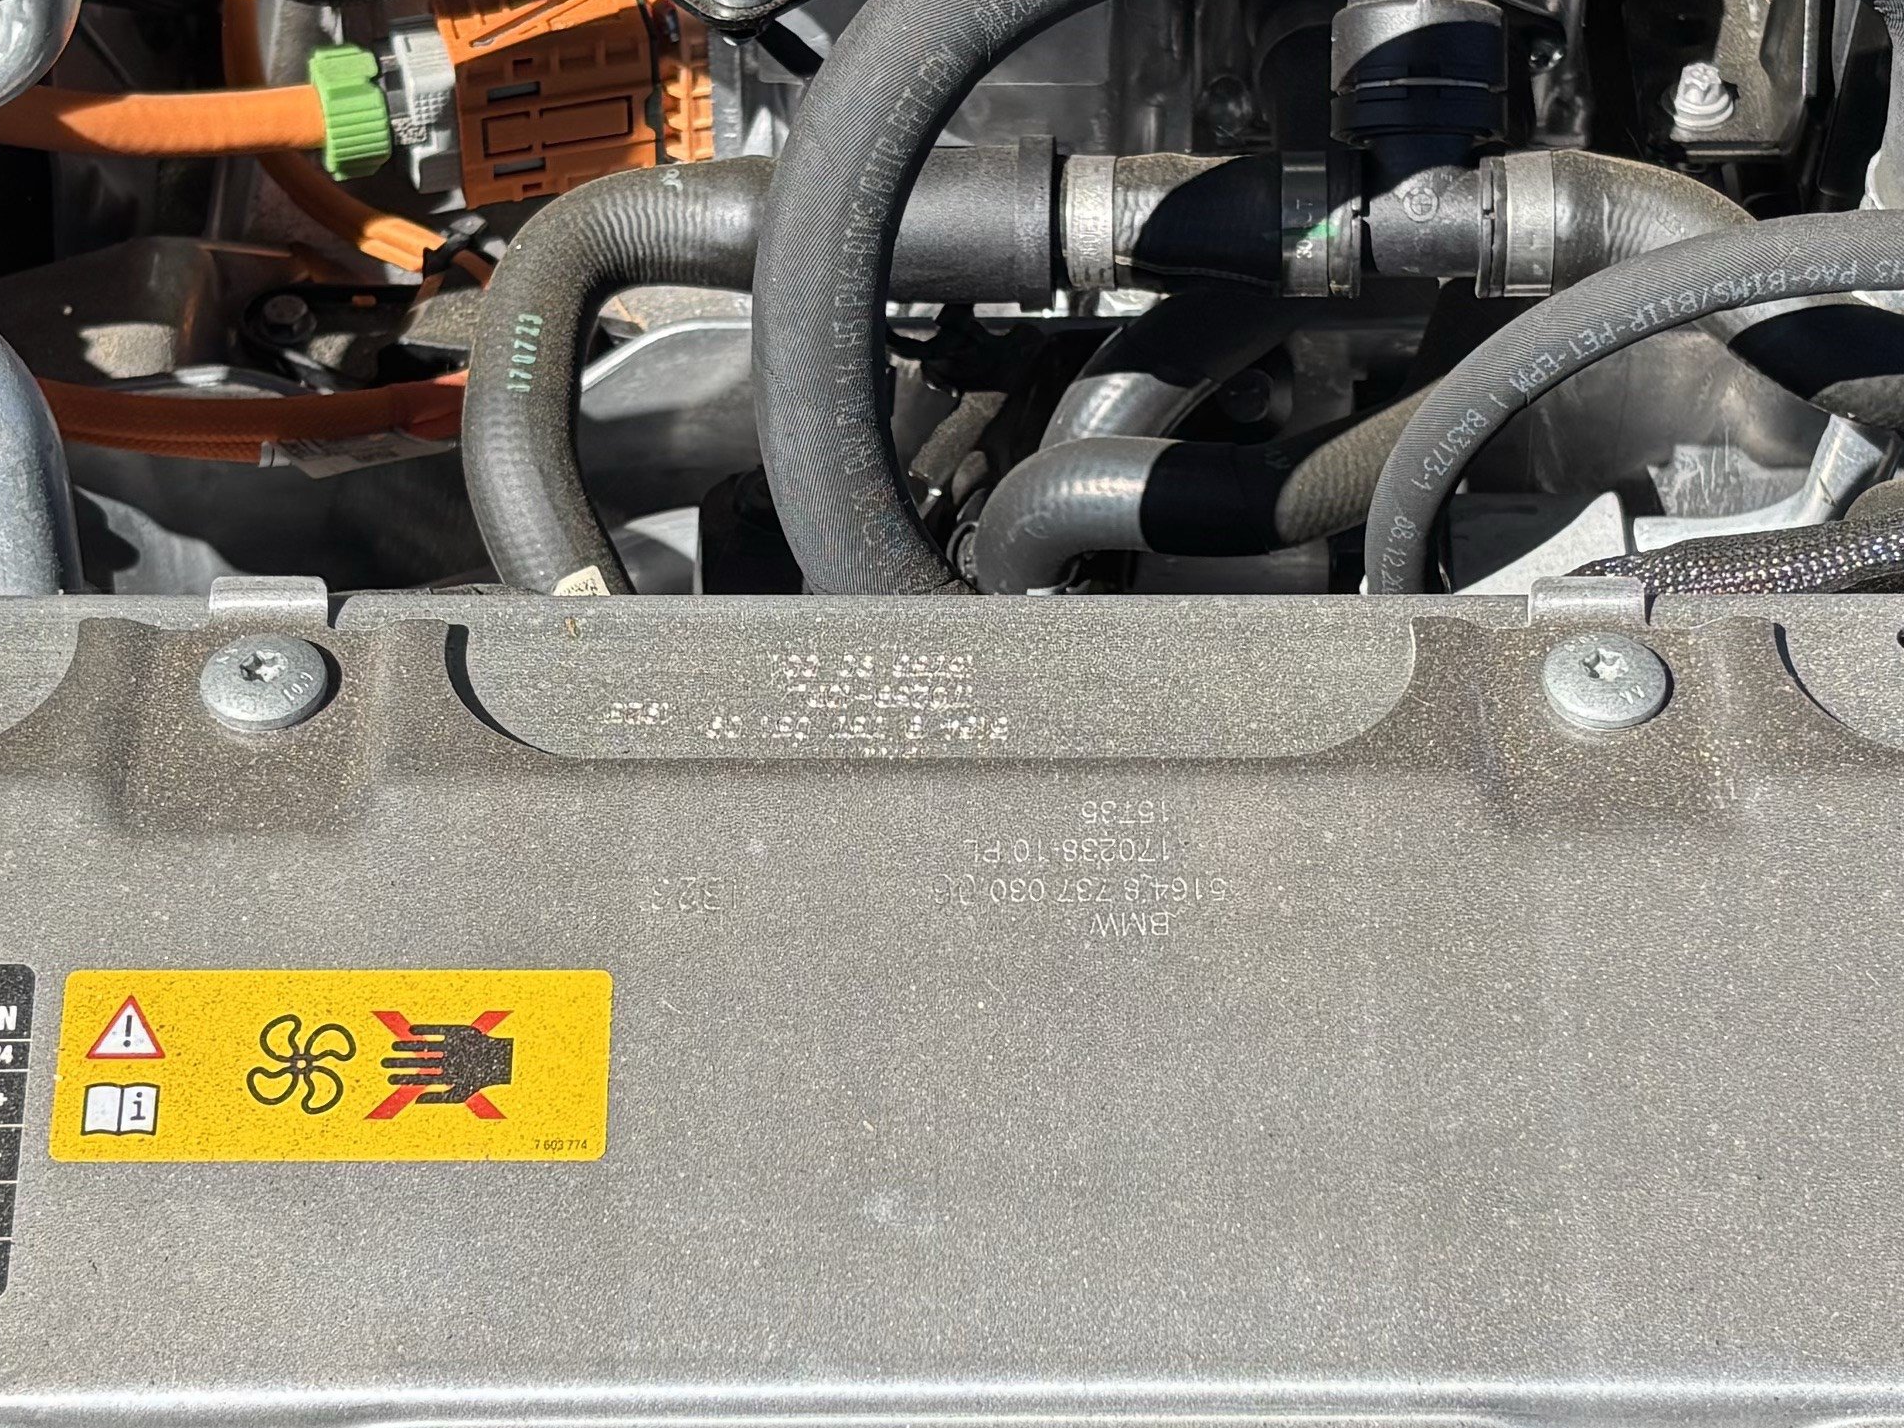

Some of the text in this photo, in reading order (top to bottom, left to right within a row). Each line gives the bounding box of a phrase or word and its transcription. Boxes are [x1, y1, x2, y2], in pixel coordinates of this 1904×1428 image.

[507, 313, 544, 393] 170723
[990, 877, 1045, 903] 030
[1057, 877, 1112, 903] 737
[1089, 911, 1170, 937] BMW
[567, 1139, 588, 1151] 774
